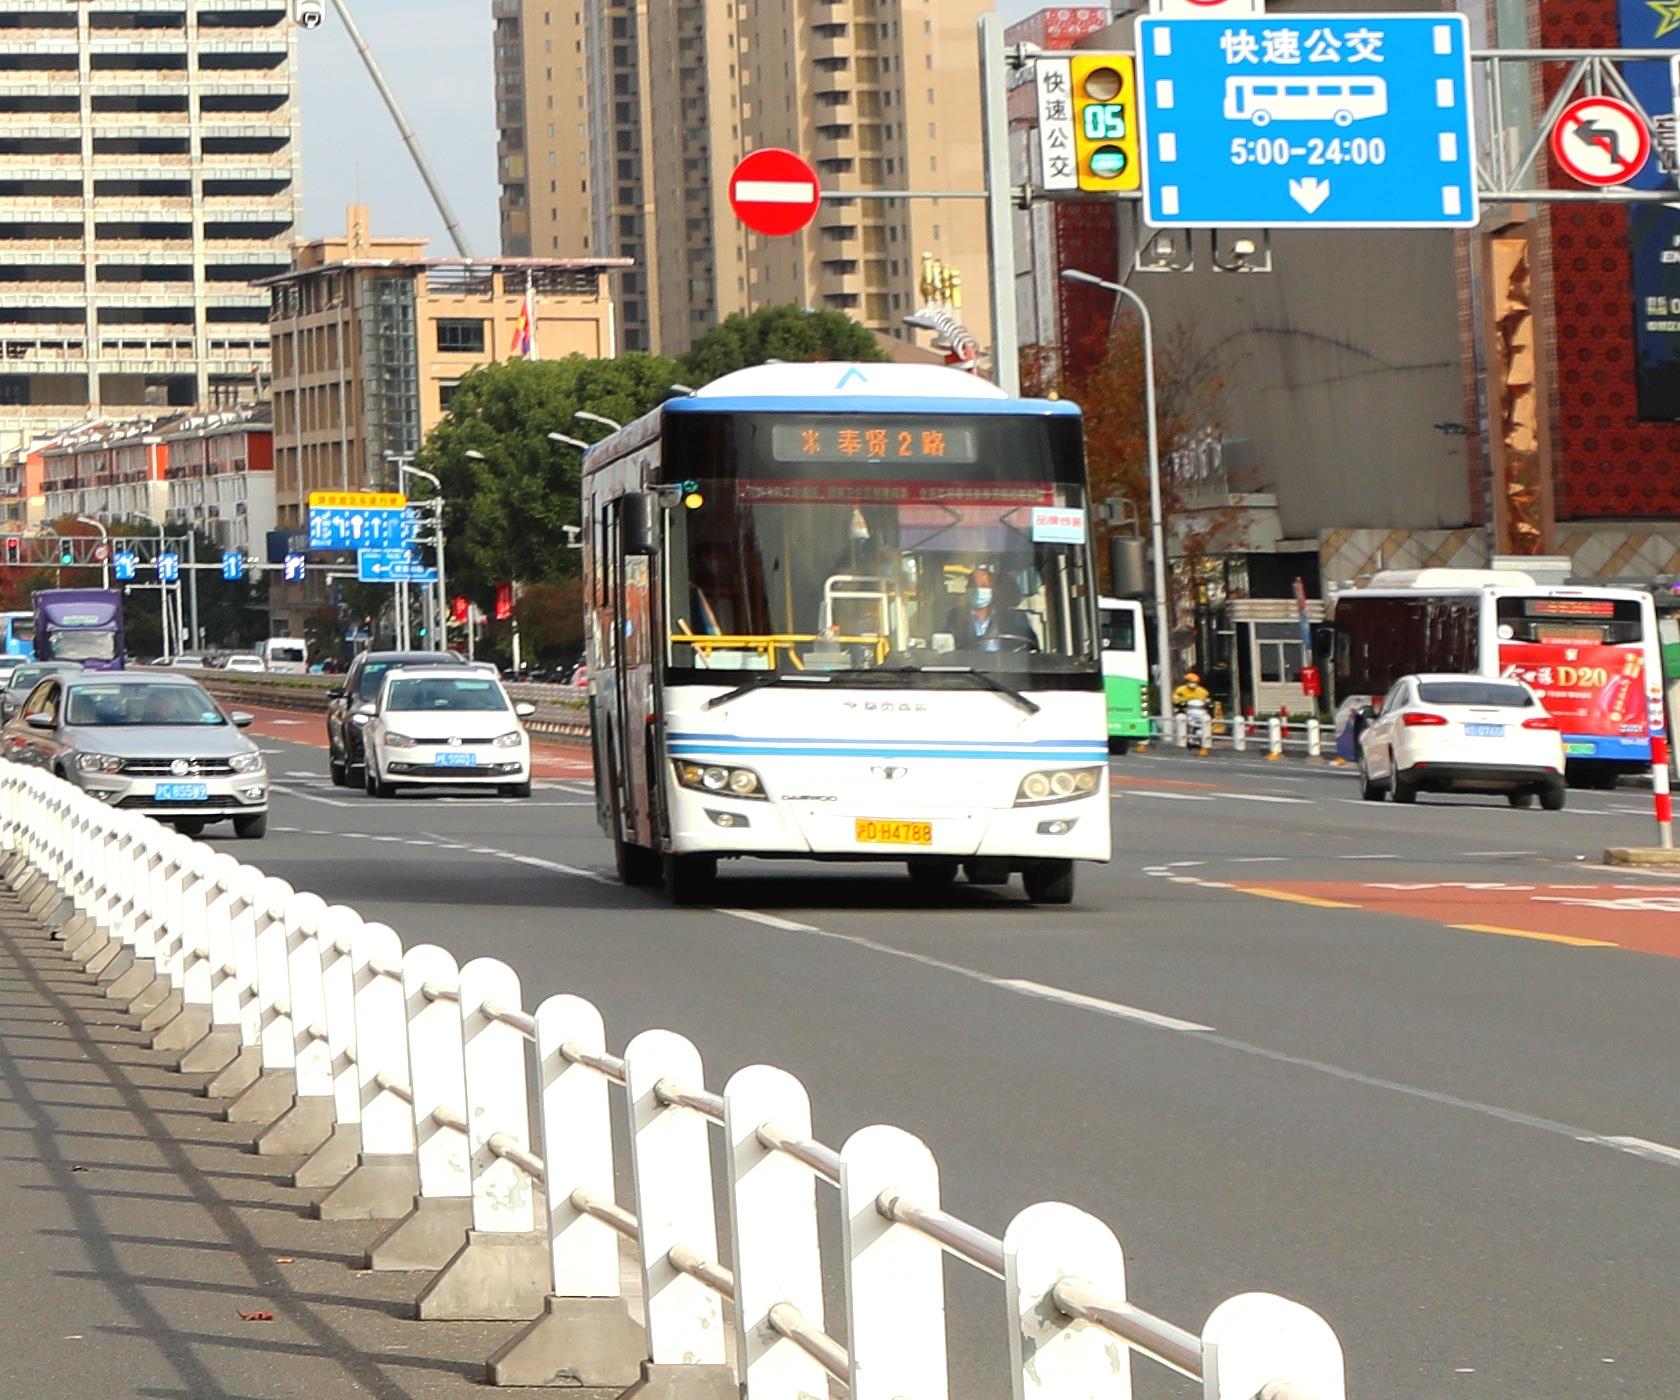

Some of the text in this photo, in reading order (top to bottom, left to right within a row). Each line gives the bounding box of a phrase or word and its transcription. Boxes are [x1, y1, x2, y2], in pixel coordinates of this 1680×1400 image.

[1220, 28, 1385, 64] 快速公交
[1043, 71, 1071, 178] 快速公交
[1084, 104, 1126, 139] 05
[1230, 137, 1386, 165] 5:00-24:00
[1557, 667, 1607, 687] D20
